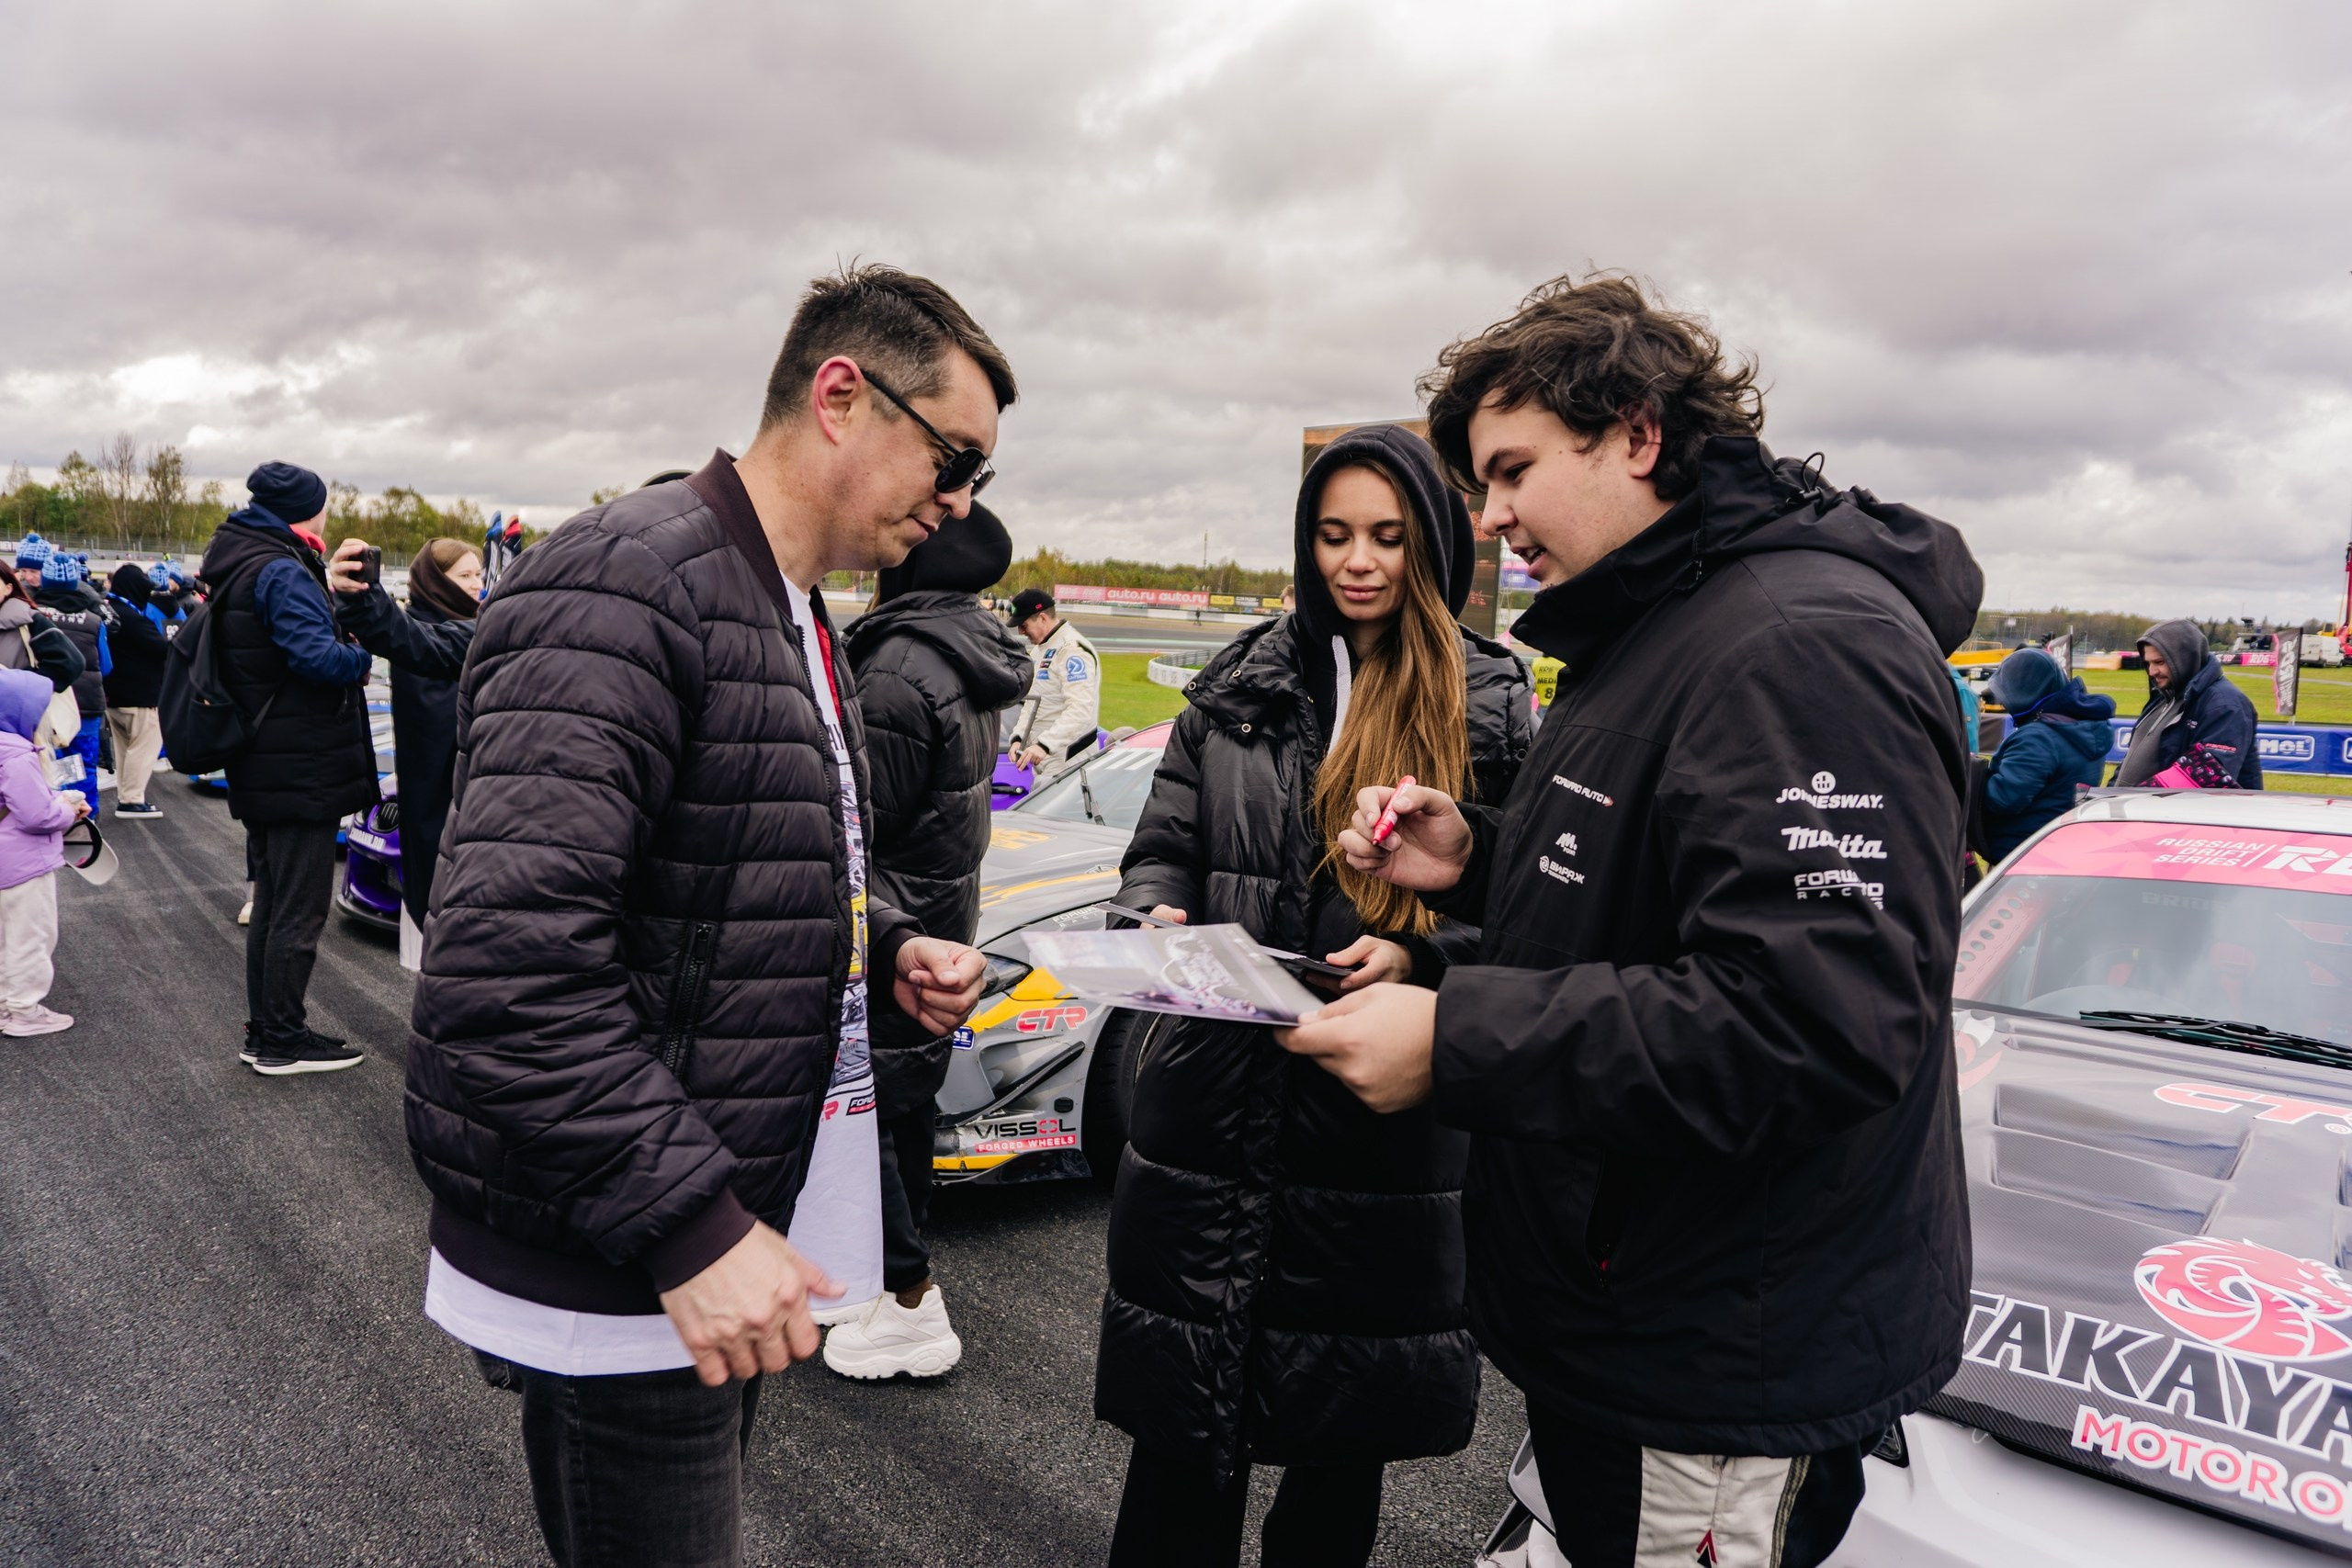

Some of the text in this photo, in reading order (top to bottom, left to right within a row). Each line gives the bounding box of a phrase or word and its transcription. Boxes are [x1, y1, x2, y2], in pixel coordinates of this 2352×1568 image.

[1107, 589, 1155, 601] auto.ru
[1159, 592, 1206, 604] auto.ru
[1537, 677, 1557, 685] MEDI
[1544, 687, 1555, 700] 8
[2259, 740, 2310, 756] MOL
[1580, 786, 1605, 804] AUTO
[2156, 837, 2266, 852] RUSSIAN
[2153, 854, 2242, 867] SERIES
[2179, 847, 2255, 859] DRIFT
[1549, 861, 1586, 885] ВИРАЖ
[1016, 1006, 1088, 1033] CTR
[2153, 1082, 2352, 1124] CT
[974, 1119, 1076, 1139] VISSOL
[978, 1136, 1074, 1152] FORGED WHEELS
